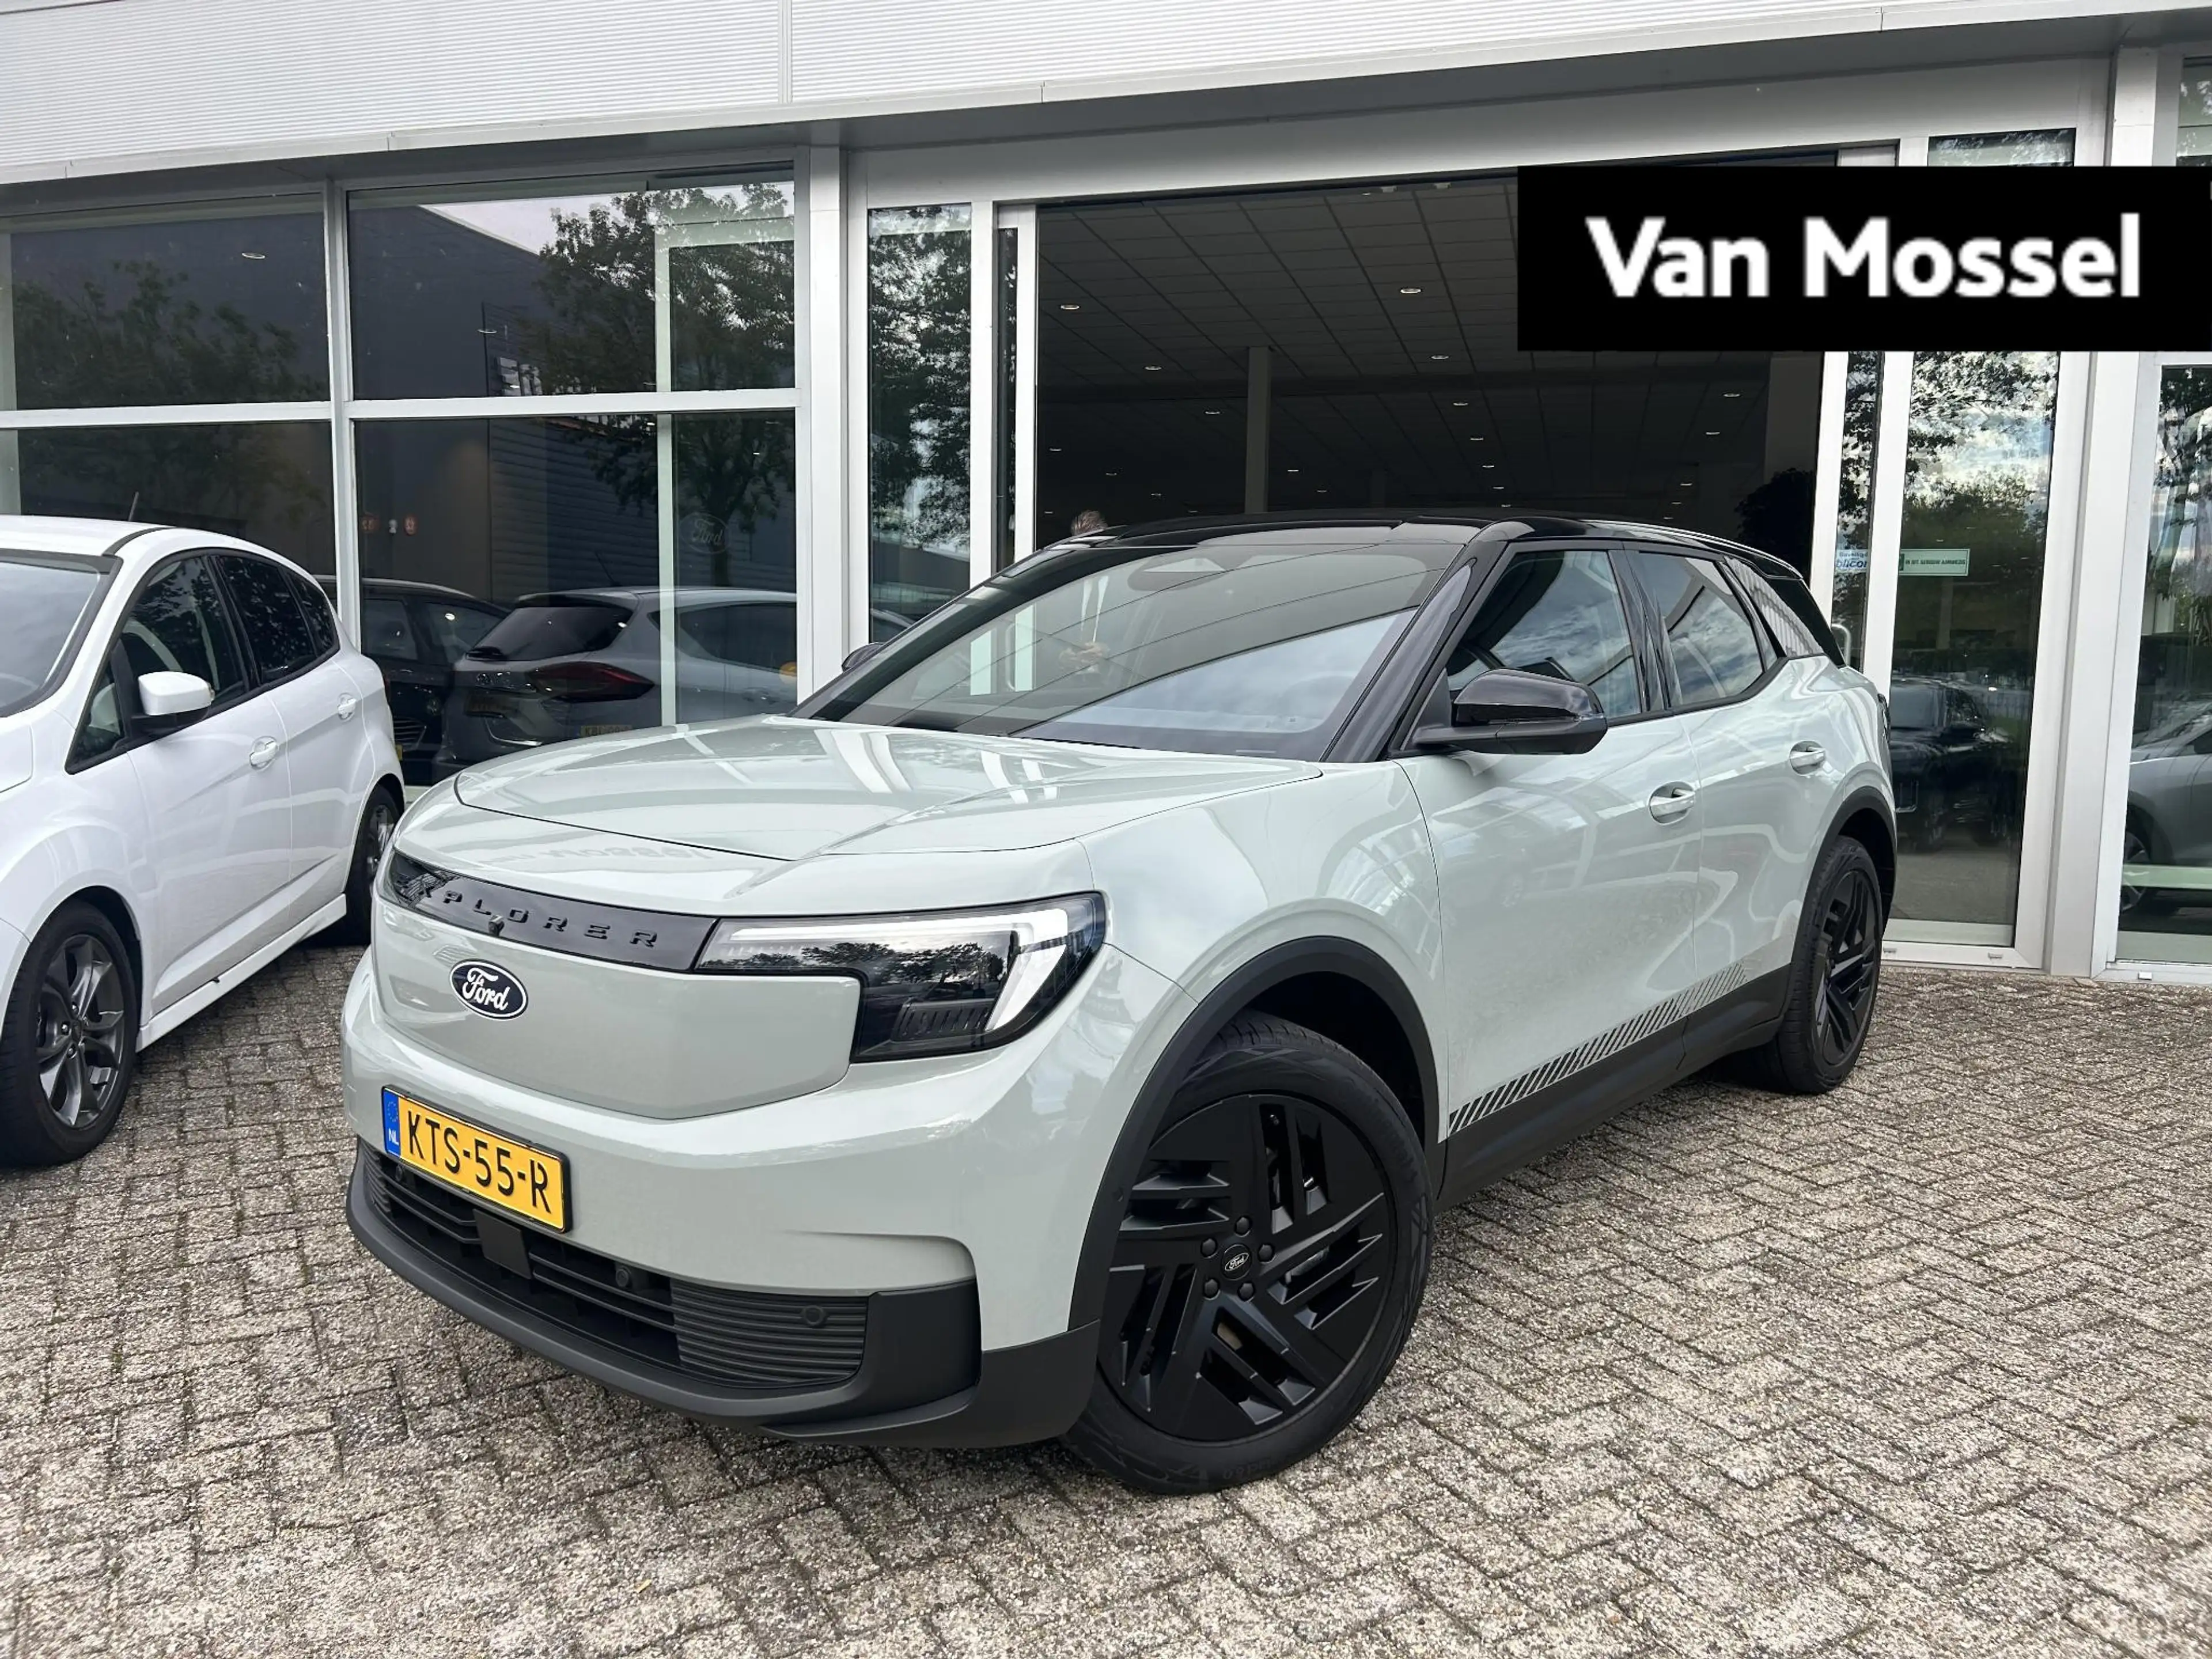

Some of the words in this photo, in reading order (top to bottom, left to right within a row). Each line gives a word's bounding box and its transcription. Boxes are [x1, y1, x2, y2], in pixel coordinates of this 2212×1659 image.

[691, 517, 724, 545] Ford
[388, 1128, 399, 1146] NL
[408, 1109, 552, 1214] KTS-55-R
